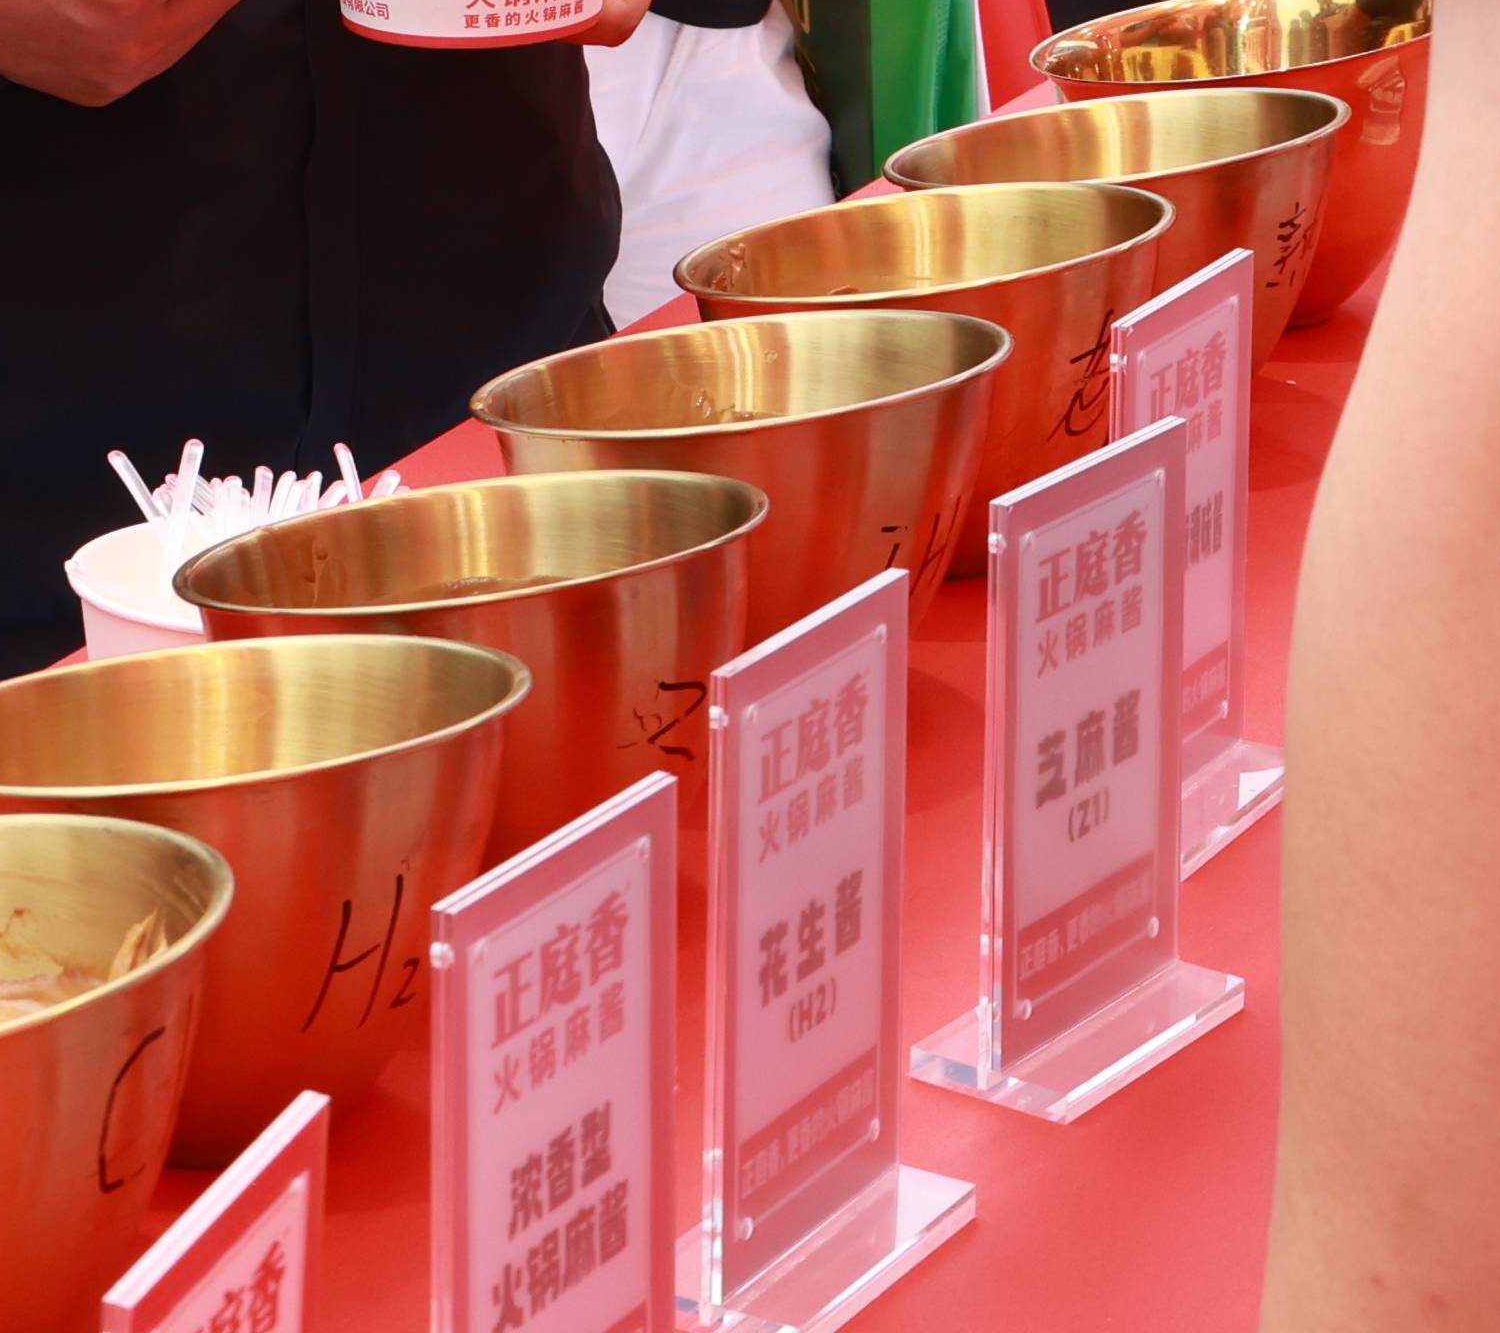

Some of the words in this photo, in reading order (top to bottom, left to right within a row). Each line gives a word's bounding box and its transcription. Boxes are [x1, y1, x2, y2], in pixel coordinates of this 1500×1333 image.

[1149, 329, 1227, 423] 正庭香
[1036, 508, 1147, 624] 正庭香
[1037, 586, 1144, 679] 火锅麻酱
[757, 670, 870, 805] 正庭香
[1035, 688, 1141, 810] 芝麻酱
[758, 755, 865, 864] 火锅麻酱
[490, 890, 629, 1052] 正庭香
[757, 869, 864, 1008] 花生酱
[491, 980, 626, 1114] 火锅麻酱
[786, 978, 837, 1044] (H2)
[508, 1099, 612, 1242] 浓香型
[491, 1179, 629, 1333] 火锅麻酱
